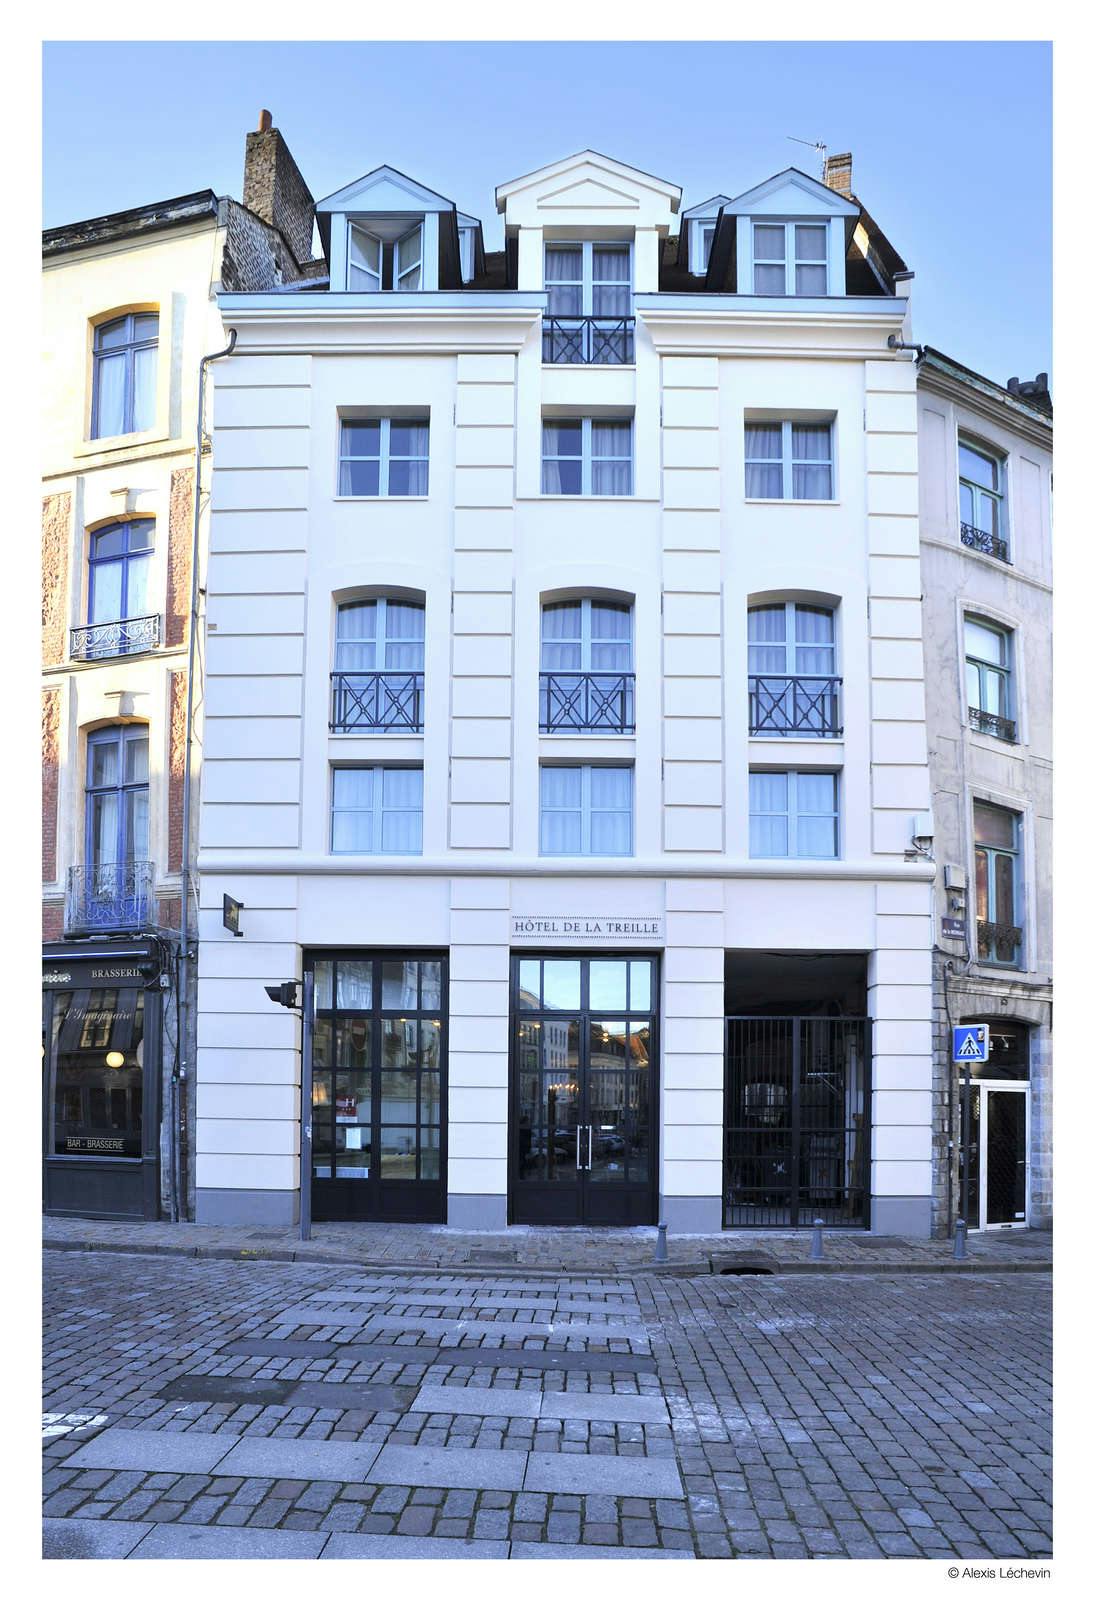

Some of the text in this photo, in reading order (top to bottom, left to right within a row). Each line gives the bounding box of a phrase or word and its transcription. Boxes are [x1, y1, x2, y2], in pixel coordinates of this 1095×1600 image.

[514, 919, 659, 933] HÔTEL DE LA TREILLE
[91, 969, 143, 978] BRASSERIE
[67, 1139, 81, 1148] BAR
[87, 1139, 124, 1150] BRASSERIE
